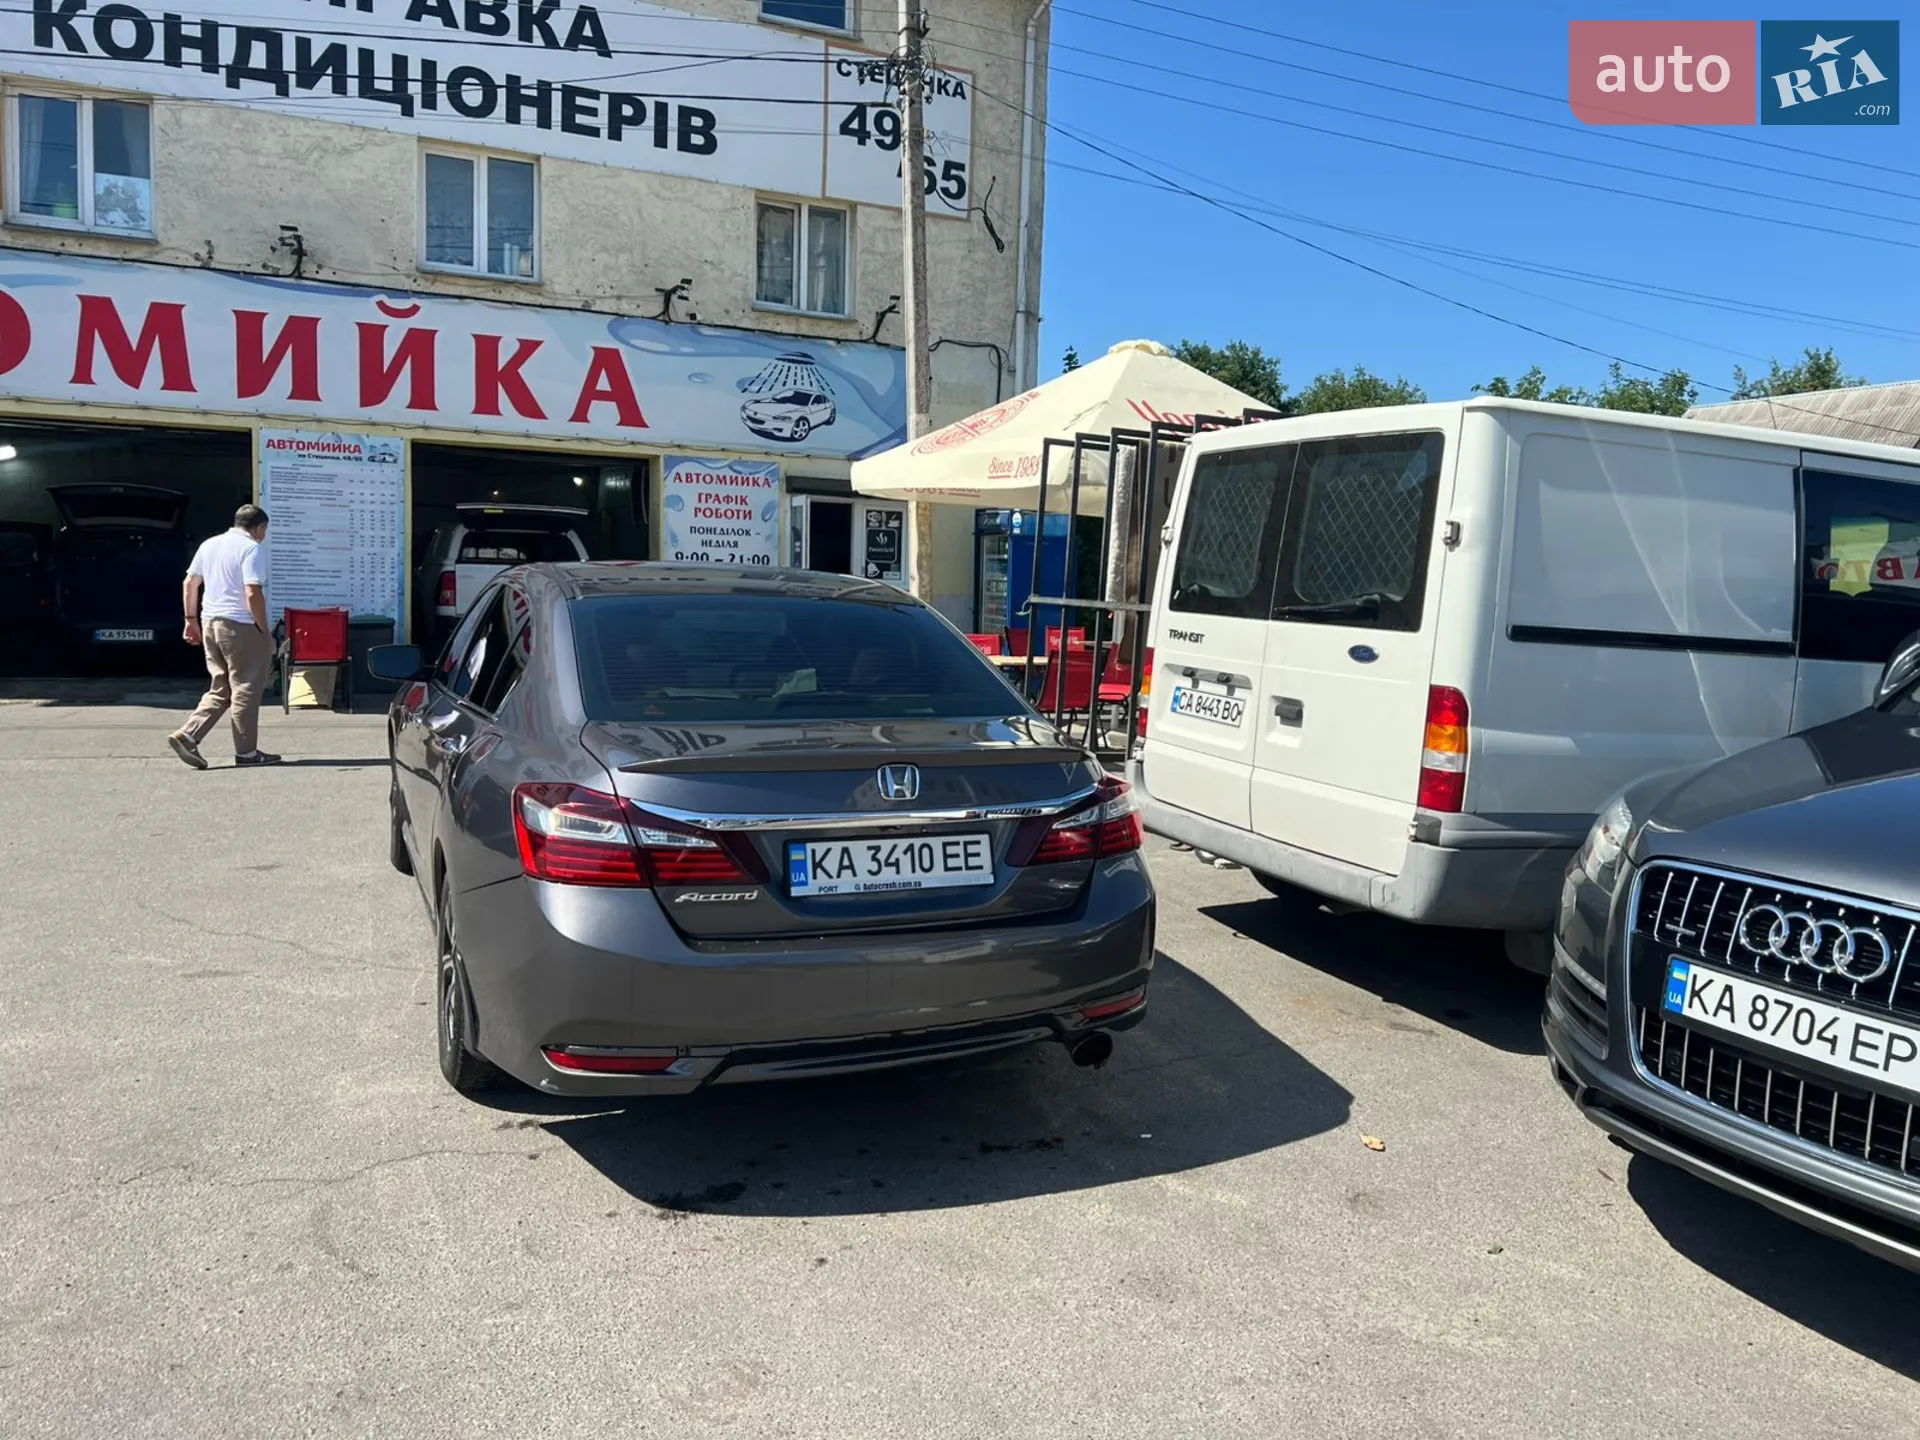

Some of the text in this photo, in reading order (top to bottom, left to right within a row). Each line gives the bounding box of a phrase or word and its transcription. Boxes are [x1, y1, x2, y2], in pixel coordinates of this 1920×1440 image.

[303, 0, 613, 58] АВКА
[34, 0, 718, 156] КОНДИЦІОНЕРІВ
[836, 58, 966, 100] СТЕЦНКА
[266, 439, 362, 454] АВТОМИЙКА
[988, 456, 1013, 475] Since
[698, 492, 748, 506] ГРАФІК
[694, 507, 752, 520] РОБОТИ
[689, 526, 751, 537] ПОНЕДІЛОК
[701, 540, 739, 549] НЕДІЛЯ
[1169, 629, 1205, 644] TRANSIT
[1178, 692, 1193, 712] CA
[1195, 696, 1221, 718] 8443
[811, 840, 984, 880] KA 3410 EE
[791, 874, 806, 883] UA
[674, 889, 758, 903] Accord
[1668, 991, 1682, 1005] UA
[1688, 973, 1918, 1072] KA 8704 EP
